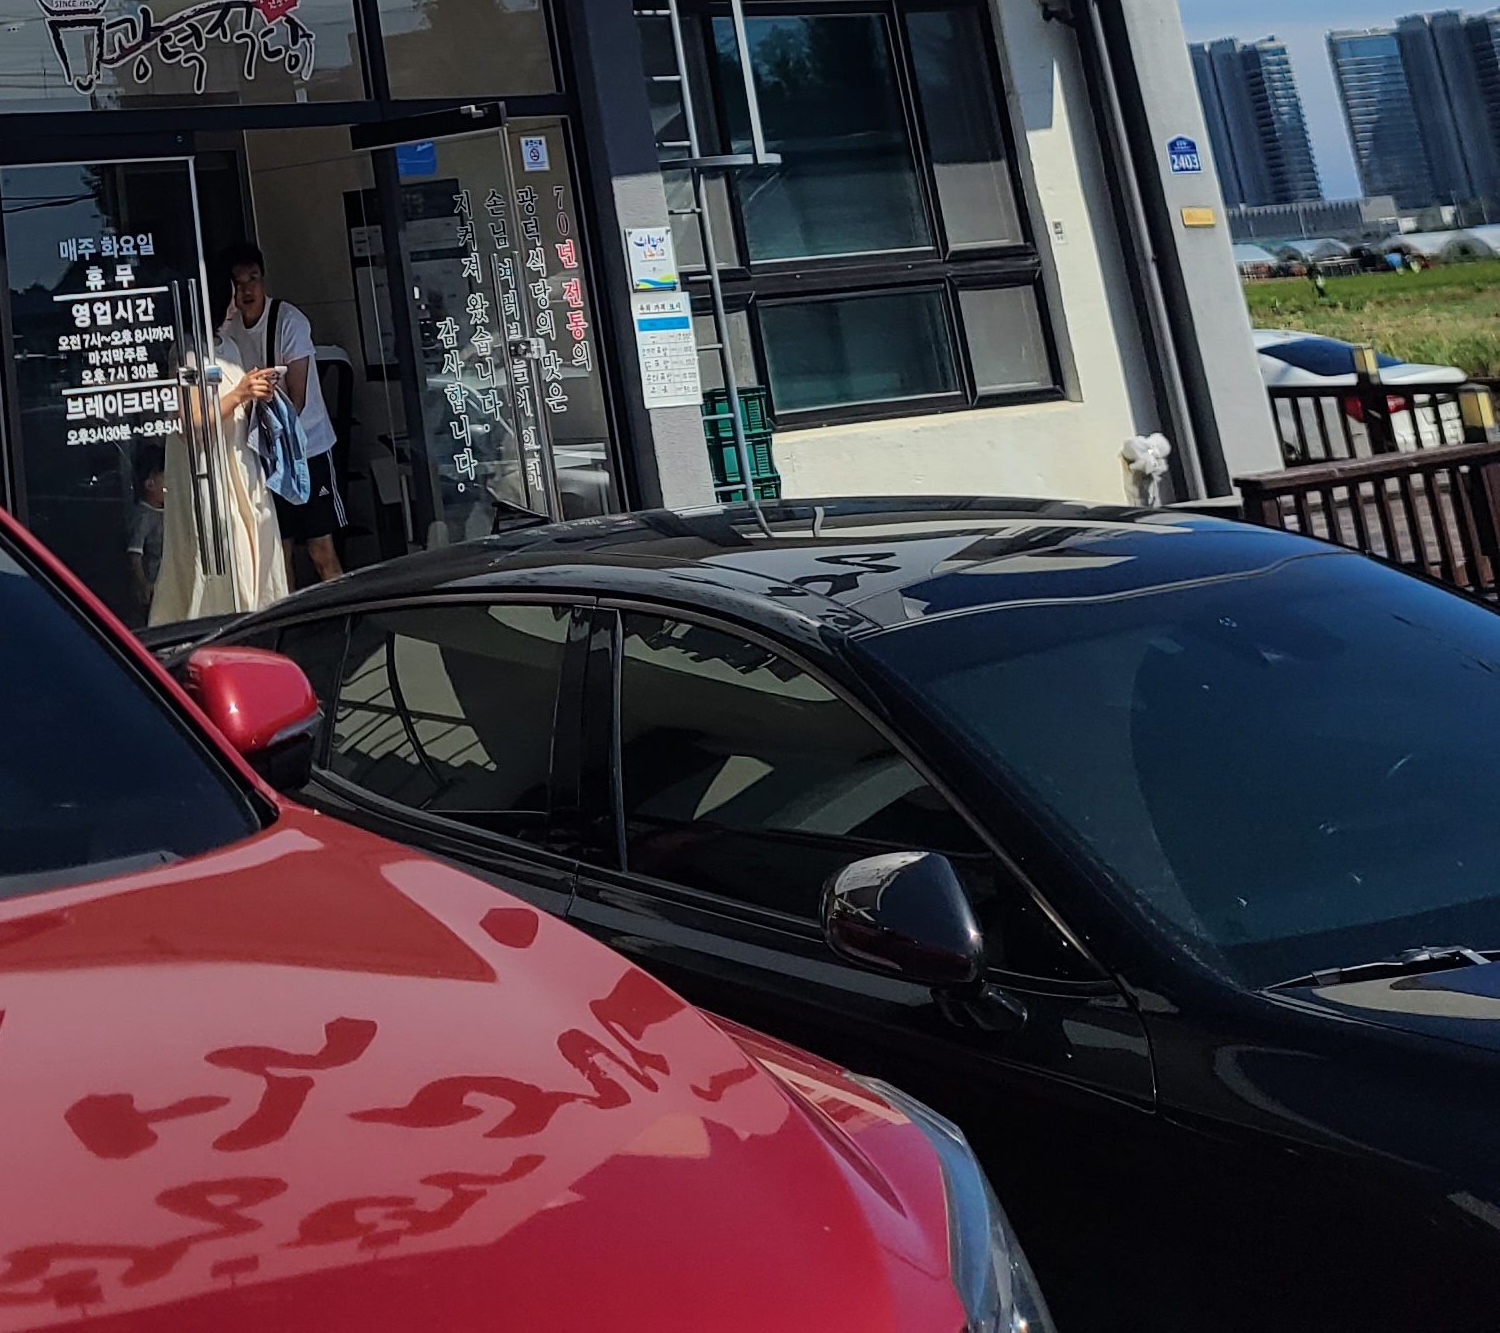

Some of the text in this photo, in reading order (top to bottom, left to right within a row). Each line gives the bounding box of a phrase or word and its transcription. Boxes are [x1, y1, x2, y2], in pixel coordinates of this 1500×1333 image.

[104, 4, 314, 94] 광덕식당
[485, 189, 510, 250] 손님
[59, 232, 155, 262] 매주 화요일
[516, 186, 557, 341] 광덕식당의
[540, 350, 569, 413] 맛은
[553, 186, 593, 372] 70년 전통의
[71, 297, 156, 328] 영업시간
[58, 334, 82, 351] 오전
[134, 325, 175, 344] 8시까지
[81, 362, 160, 385] 오후 7시 30분
[66, 386, 179, 421] 브레이크타임
[436, 317, 478, 493] 감사합니다.
